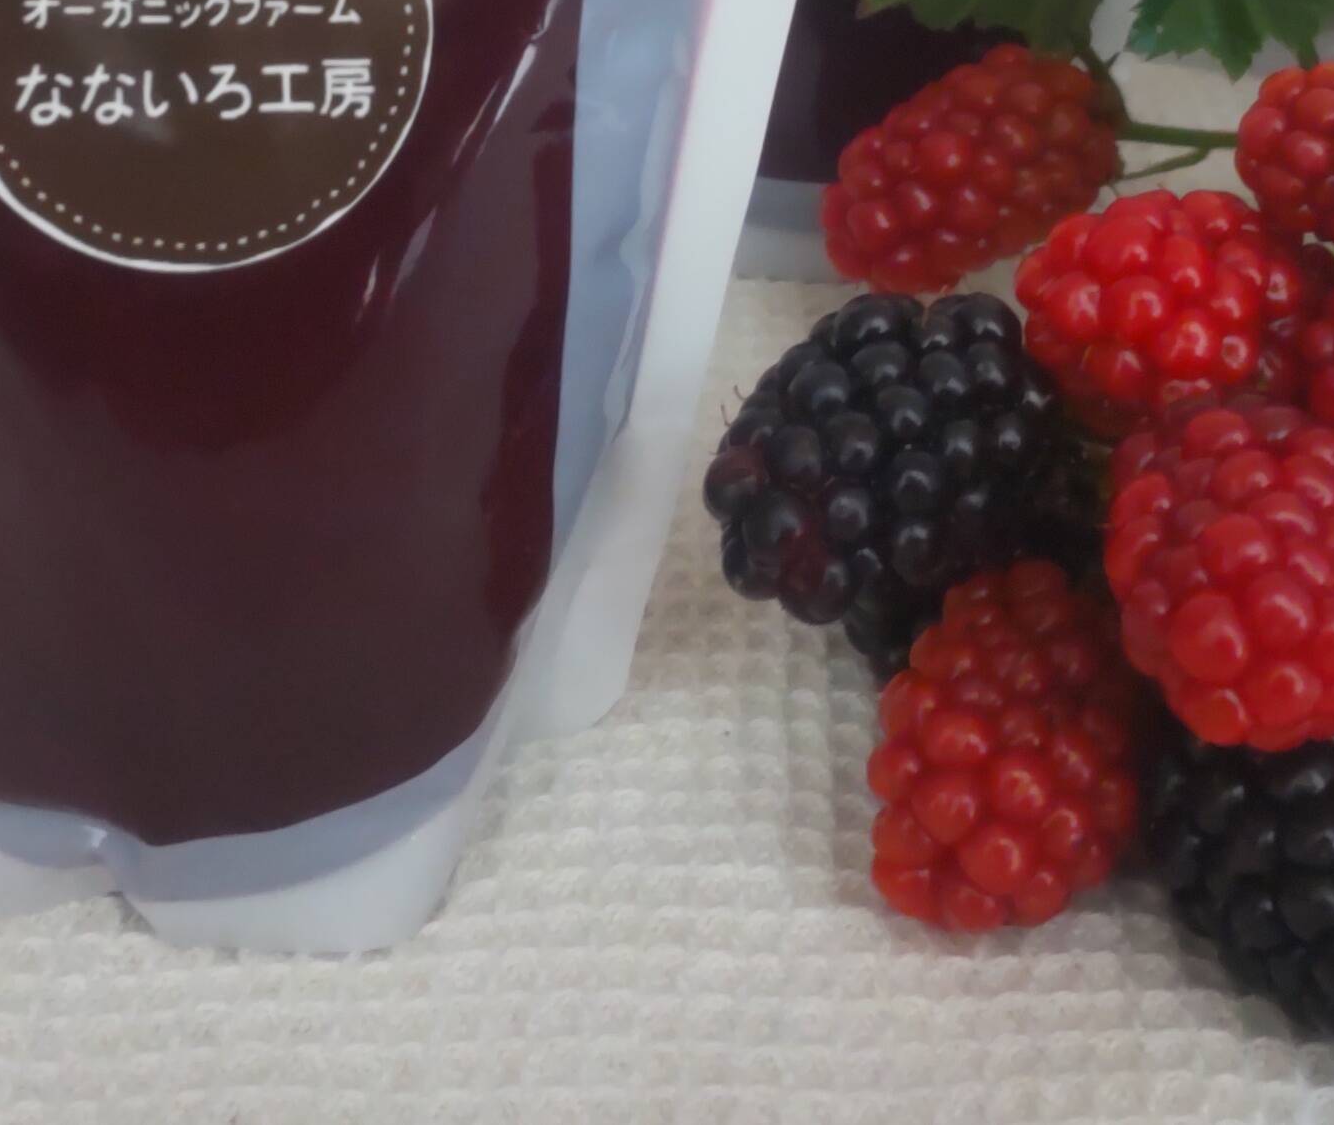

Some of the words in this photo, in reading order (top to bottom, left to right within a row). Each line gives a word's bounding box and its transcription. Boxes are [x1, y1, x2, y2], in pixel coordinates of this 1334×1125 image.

[15, 58, 376, 126] なないろ工房
